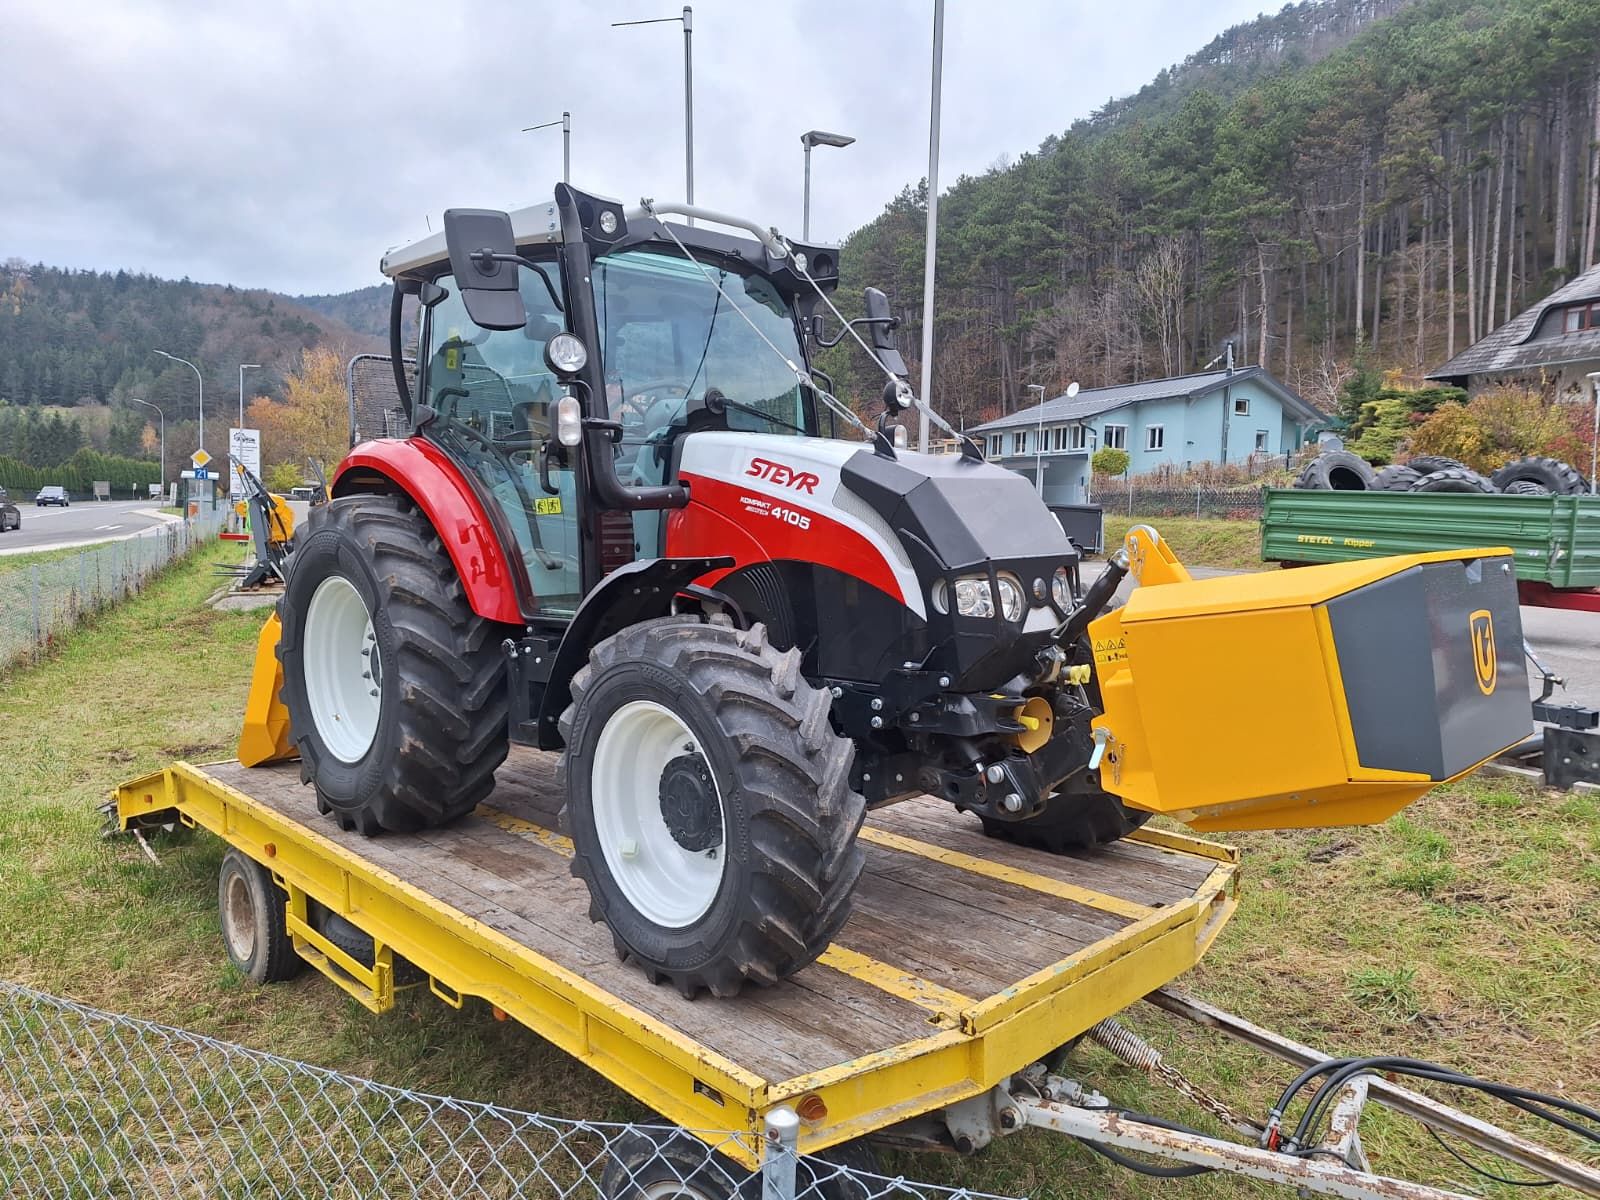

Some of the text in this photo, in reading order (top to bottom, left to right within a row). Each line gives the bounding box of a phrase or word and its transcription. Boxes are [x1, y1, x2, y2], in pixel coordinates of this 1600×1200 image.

[197, 469, 206, 478] 21
[745, 457, 820, 495] STEYR
[740, 496, 771, 509] KOMPAKT
[771, 506, 812, 530] 4105
[1297, 535, 1375, 548] STETZL Kipper
